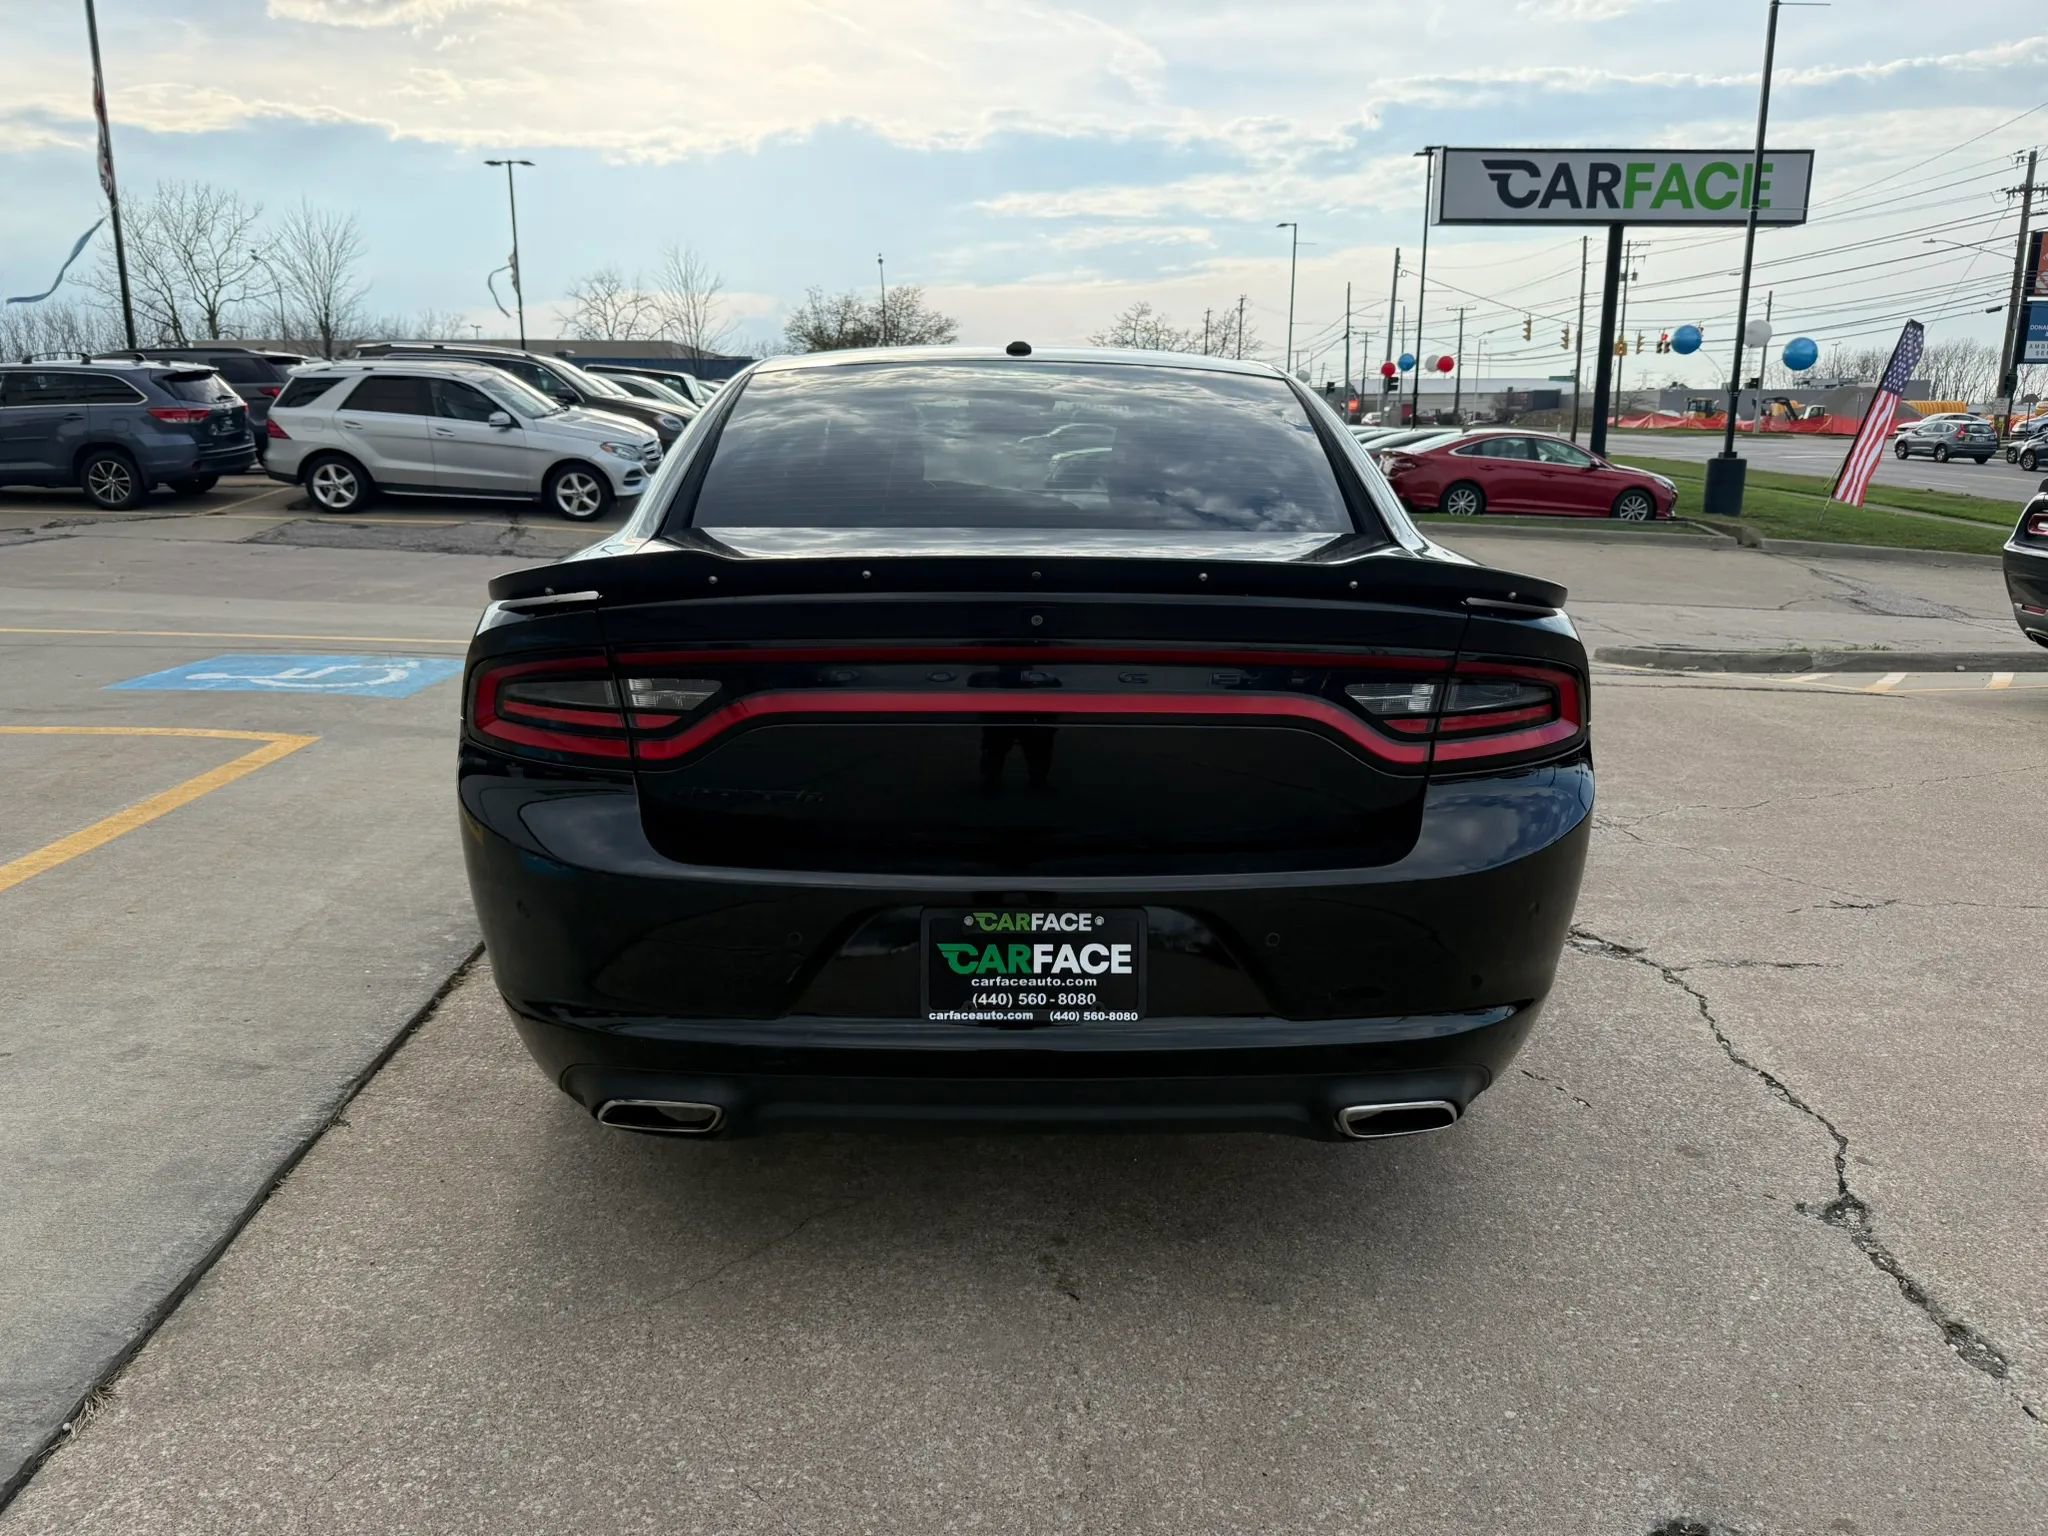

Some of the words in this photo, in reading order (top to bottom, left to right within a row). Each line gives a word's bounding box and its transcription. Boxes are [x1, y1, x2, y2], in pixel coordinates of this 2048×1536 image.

[1481, 159, 1773, 210] CARFACE
[973, 912, 1092, 932] CARFACE
[936, 943, 1133, 974] CARFACE
[971, 976, 1097, 987] carfaceauto.com
[972, 992, 1013, 1008] (440)
[928, 1010, 1034, 1021] carfaceauto.com
[1049, 1011, 1080, 1022] (440)
[1083, 1011, 1138, 1021] 560-8080
